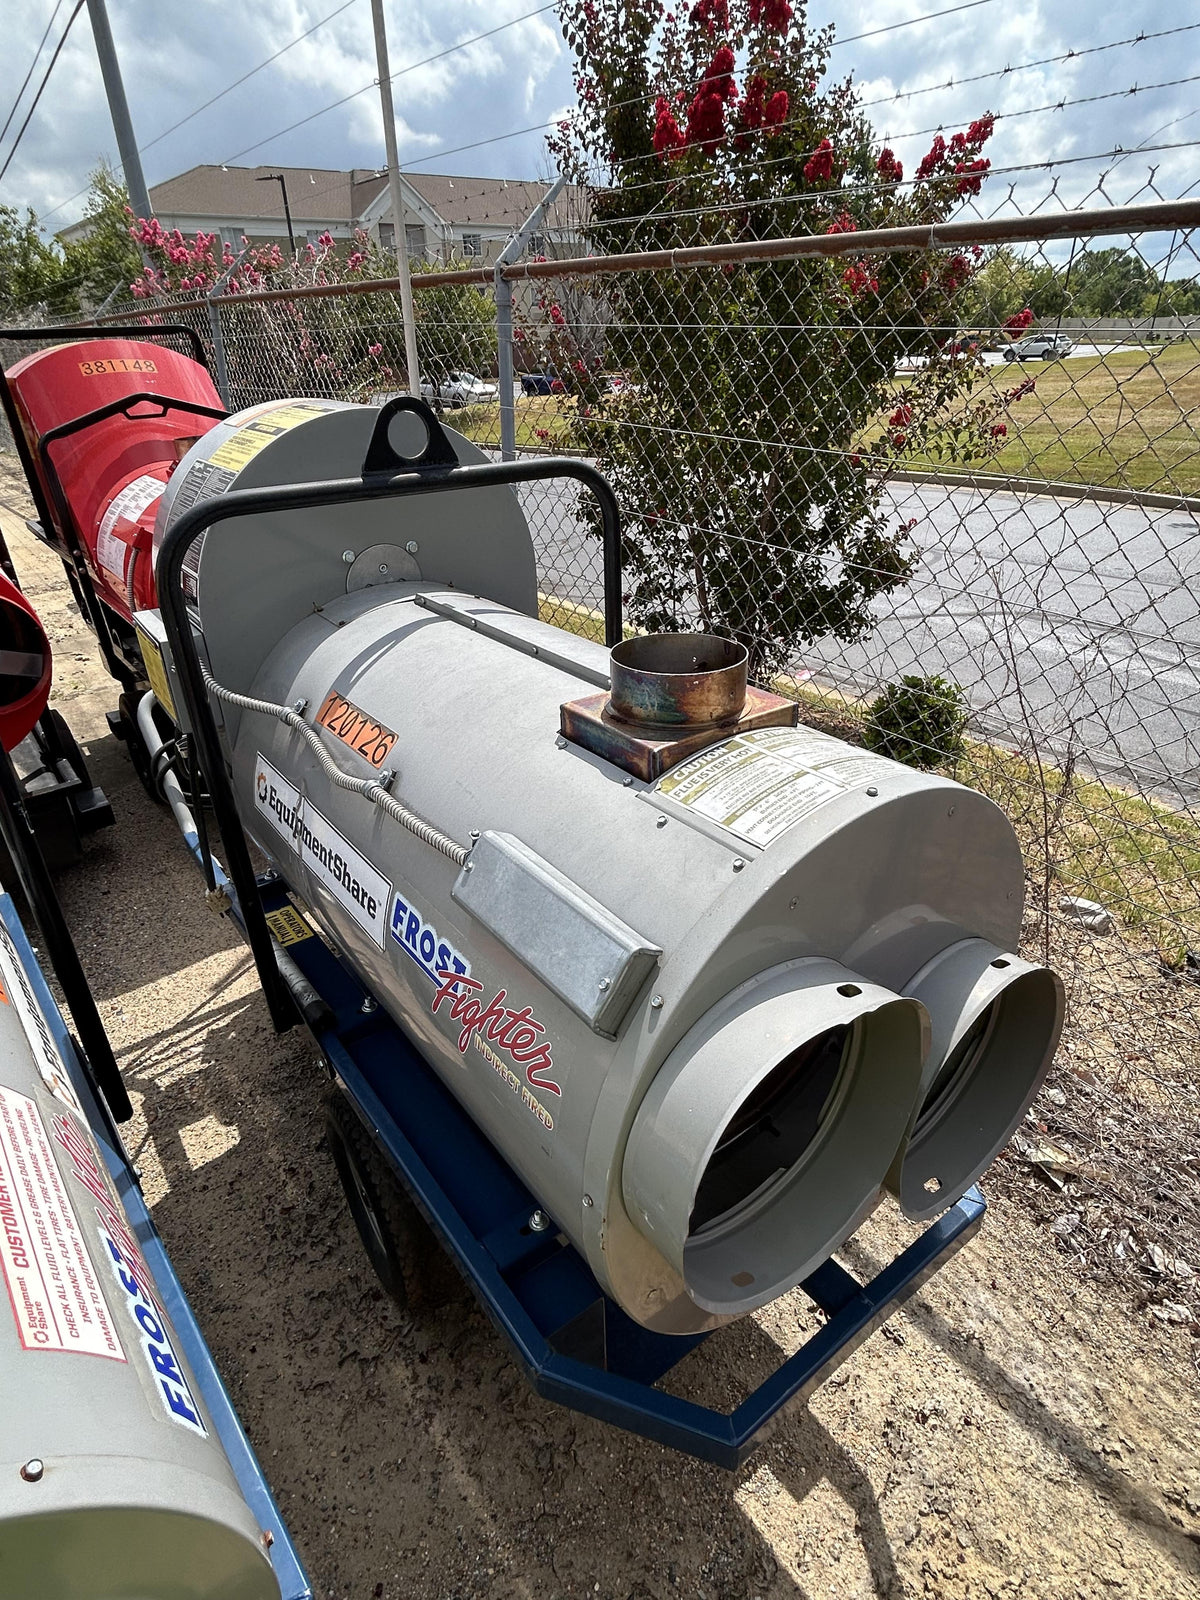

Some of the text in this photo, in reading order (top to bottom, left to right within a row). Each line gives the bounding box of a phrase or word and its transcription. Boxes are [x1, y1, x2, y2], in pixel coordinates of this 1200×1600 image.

[81, 359, 155, 375] 381148
[320, 695, 395, 765] 120126
[673, 747, 730, 780] CAUTION
[673, 748, 753, 798] FLUE IS VERY HOT
[268, 785, 377, 920] EquipmentShare
[270, 917, 292, 940] MANUAL
[280, 909, 308, 938] OPERATORS
[392, 899, 467, 993] FROST
[432, 970, 561, 1096] Fighter
[473, 1033, 553, 1130] INDIRECT FIRED
[6, 1126, 21, 1152] BEFORE
[14, 1153, 28, 1175] DAILY
[21, 1178, 39, 1209] GREASE
[14, 1108, 93, 1324] INSURANCE FLAT TIRES TIRE DAMAGE REFUELING
[24, 1101, 117, 1350] DAMAGE TO EQUIPMENT BATTERY MAINTENANCE CLEANING
[34, 1218, 51, 1250] LEVELS
[44, 1252, 61, 1281] FLUID
[16, 1276, 38, 1328] Equipment
[53, 1282, 67, 1300] ALL
[32, 1300, 48, 1329] Share
[60, 1302, 80, 1338] CHECK
[107, 1237, 199, 1425] FROST
